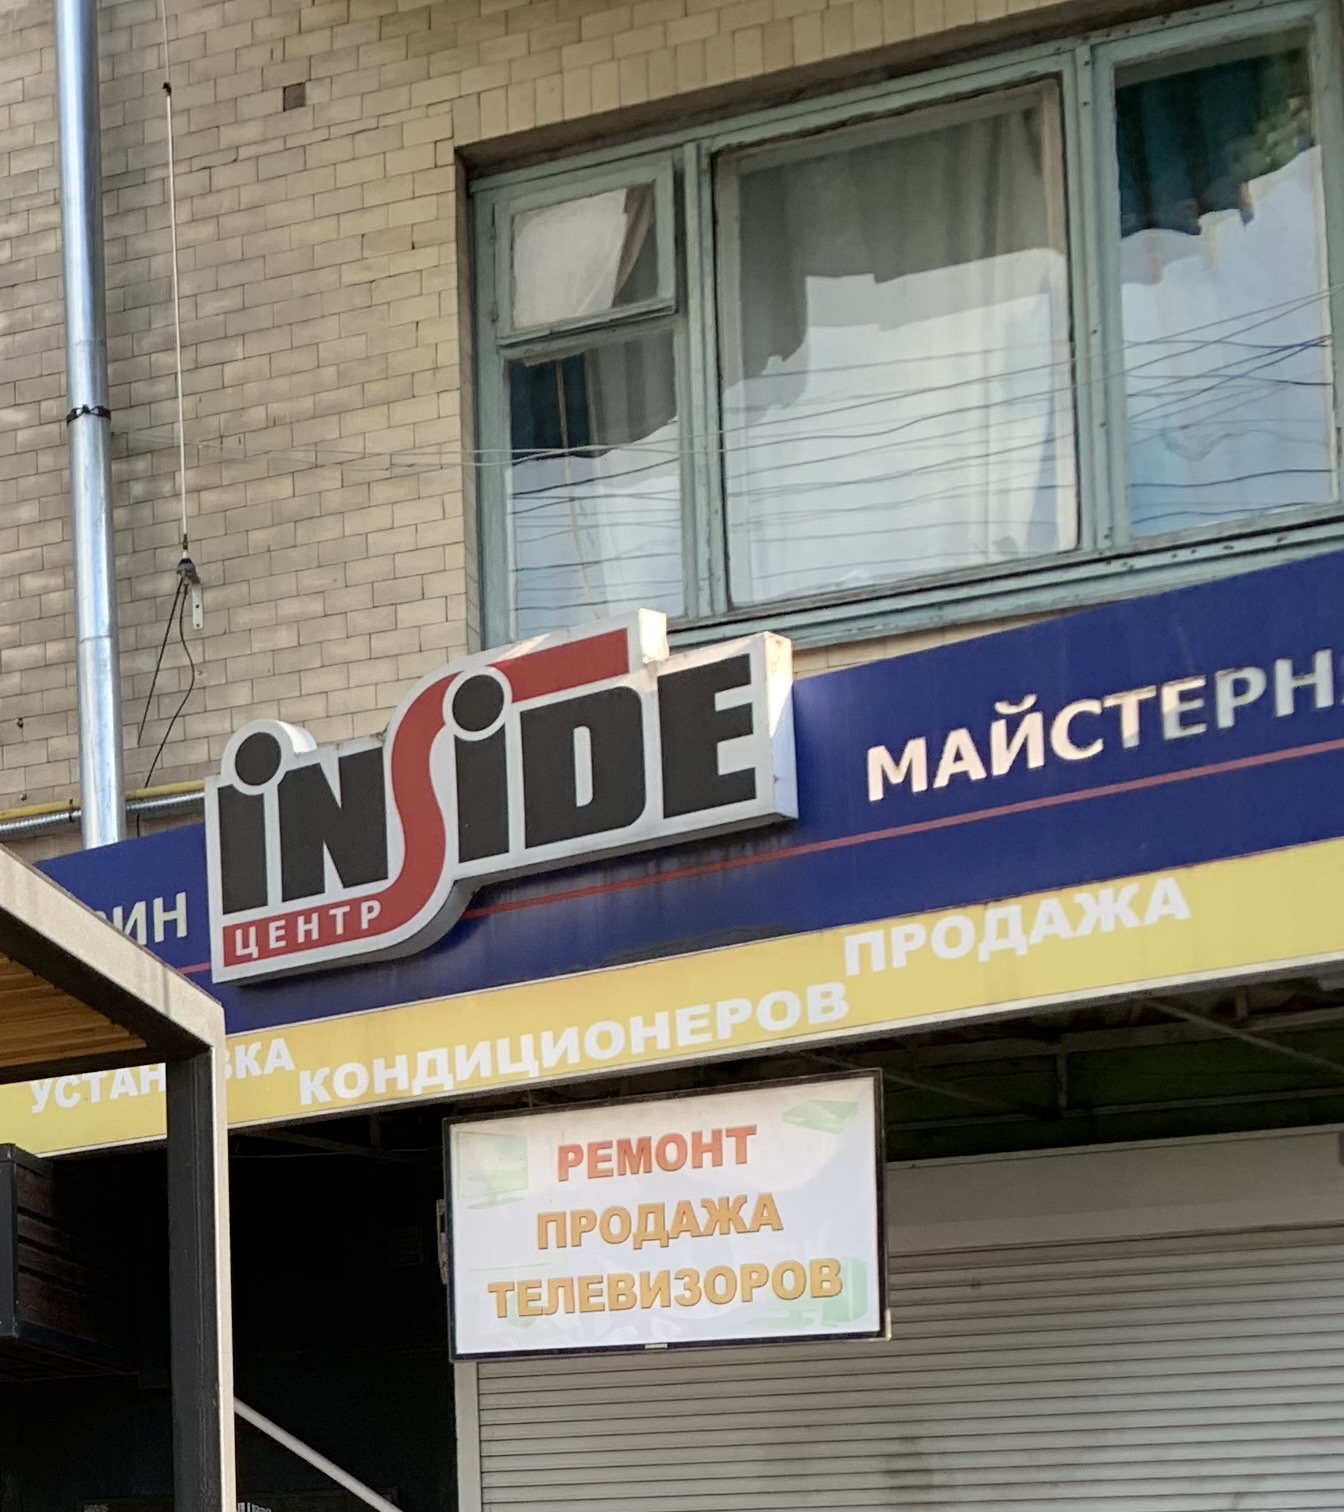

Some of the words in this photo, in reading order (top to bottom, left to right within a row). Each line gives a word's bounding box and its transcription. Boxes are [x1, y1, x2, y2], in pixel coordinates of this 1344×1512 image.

[867, 648, 1344, 803] МАЙСТЕРН
[234, 900, 382, 959] ЦЕНТР
[843, 877, 1192, 977] ПРОДАЖА
[298, 980, 849, 1105] КОНДИЦИОНЕРОВ
[557, 1124, 758, 1183] РЕМОНТ
[536, 1191, 784, 1251] ПРОДАЖА
[487, 1257, 844, 1319] ТЕЛЕВИЗОРОВ
